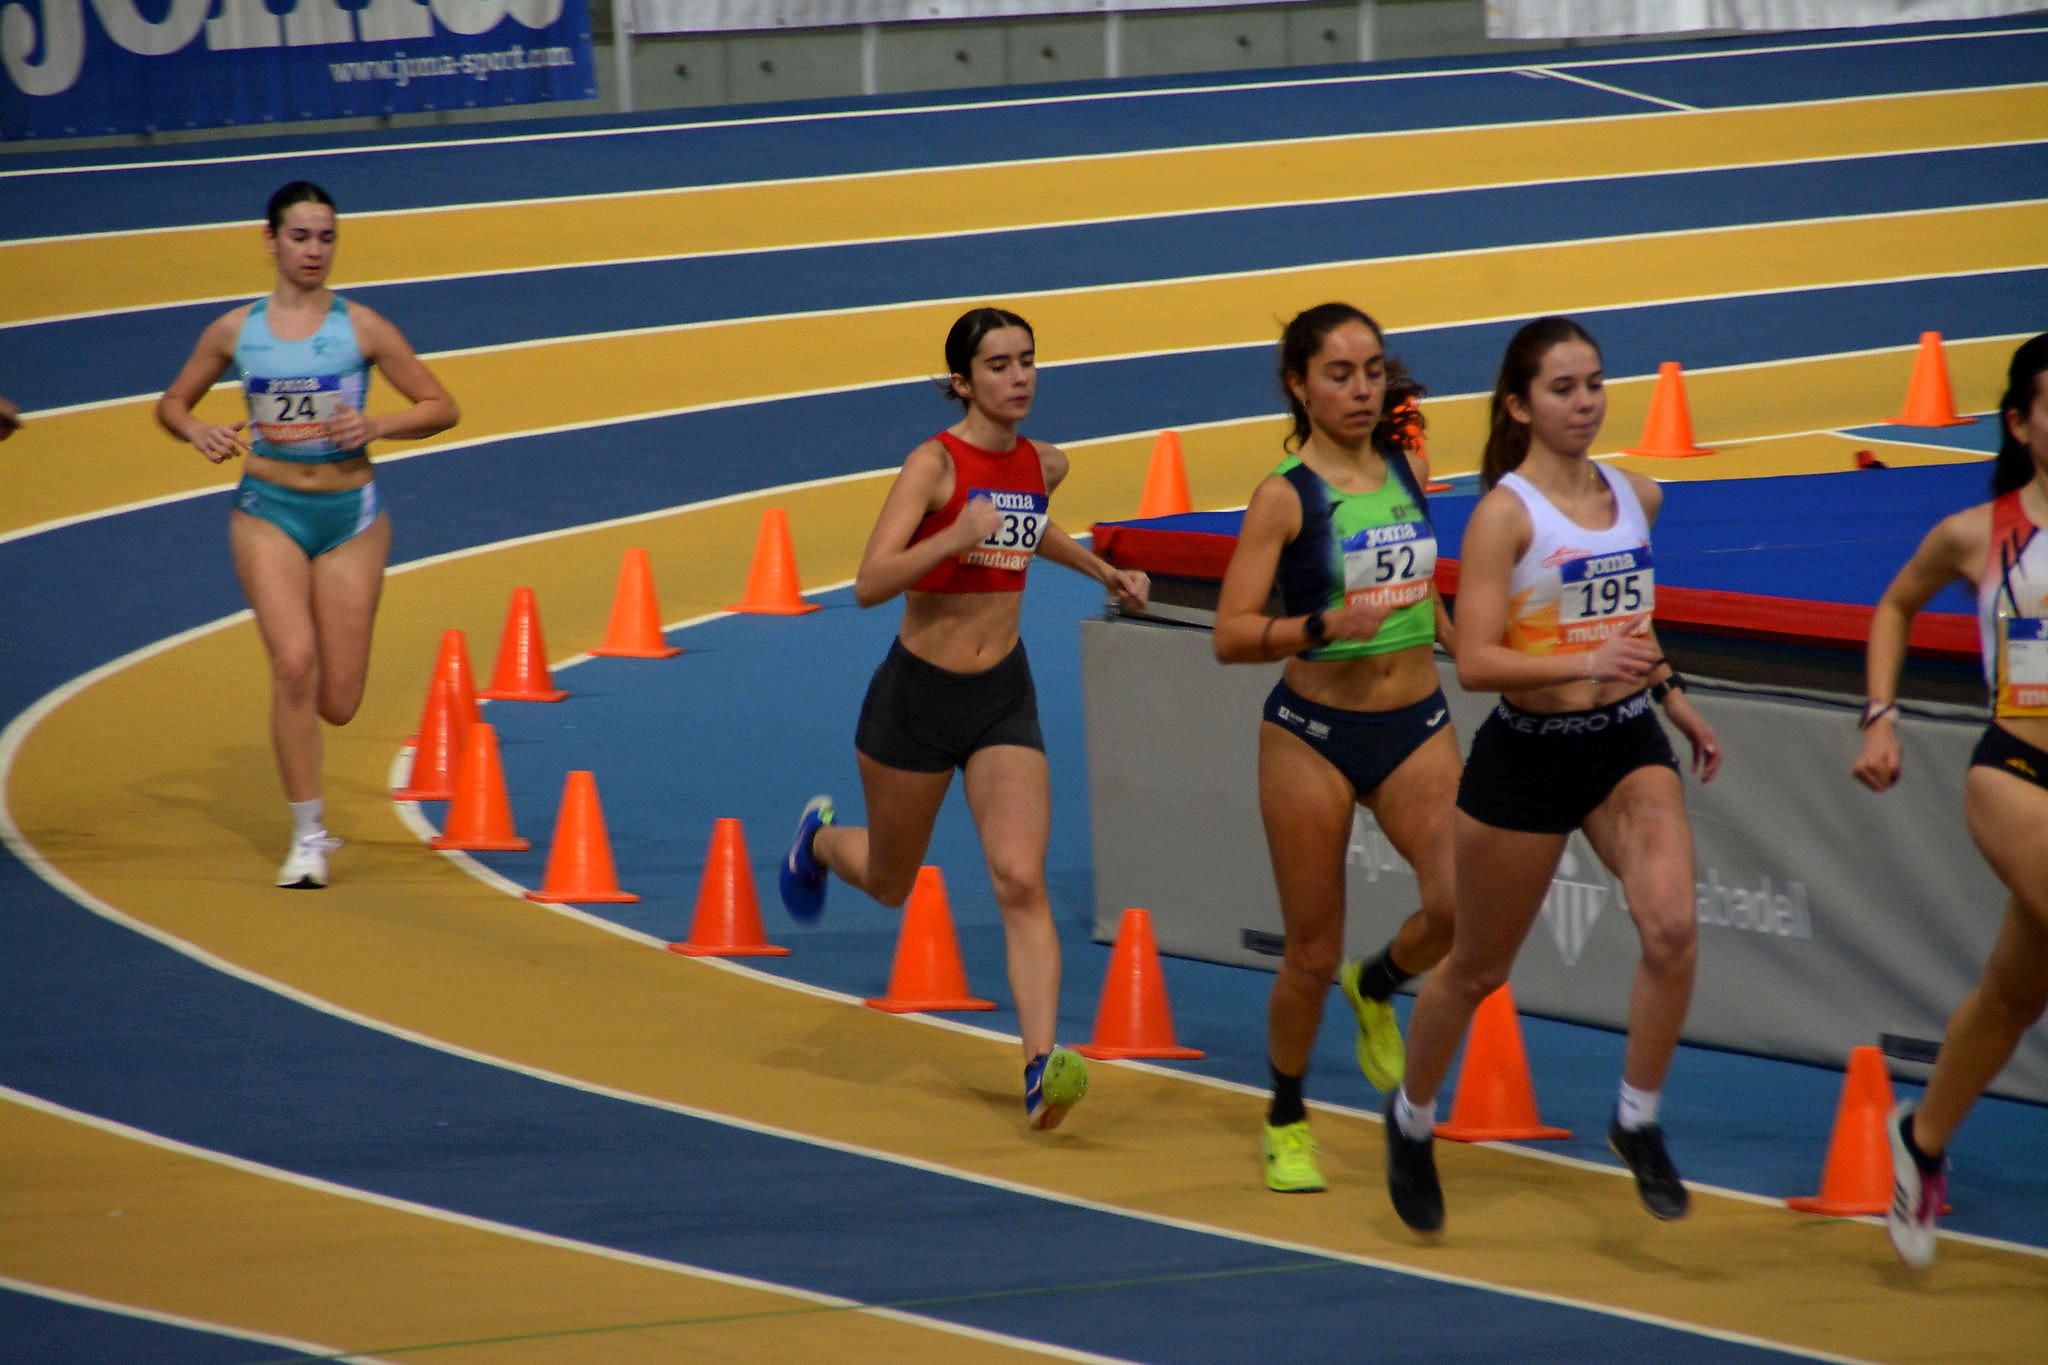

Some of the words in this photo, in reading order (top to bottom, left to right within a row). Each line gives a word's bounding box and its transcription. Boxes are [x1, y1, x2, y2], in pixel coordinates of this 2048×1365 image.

[275, 395, 317, 421] 24
[1375, 545, 1415, 582] 52
[1580, 575, 1641, 617] 195
[1539, 713, 1610, 735] PRO
